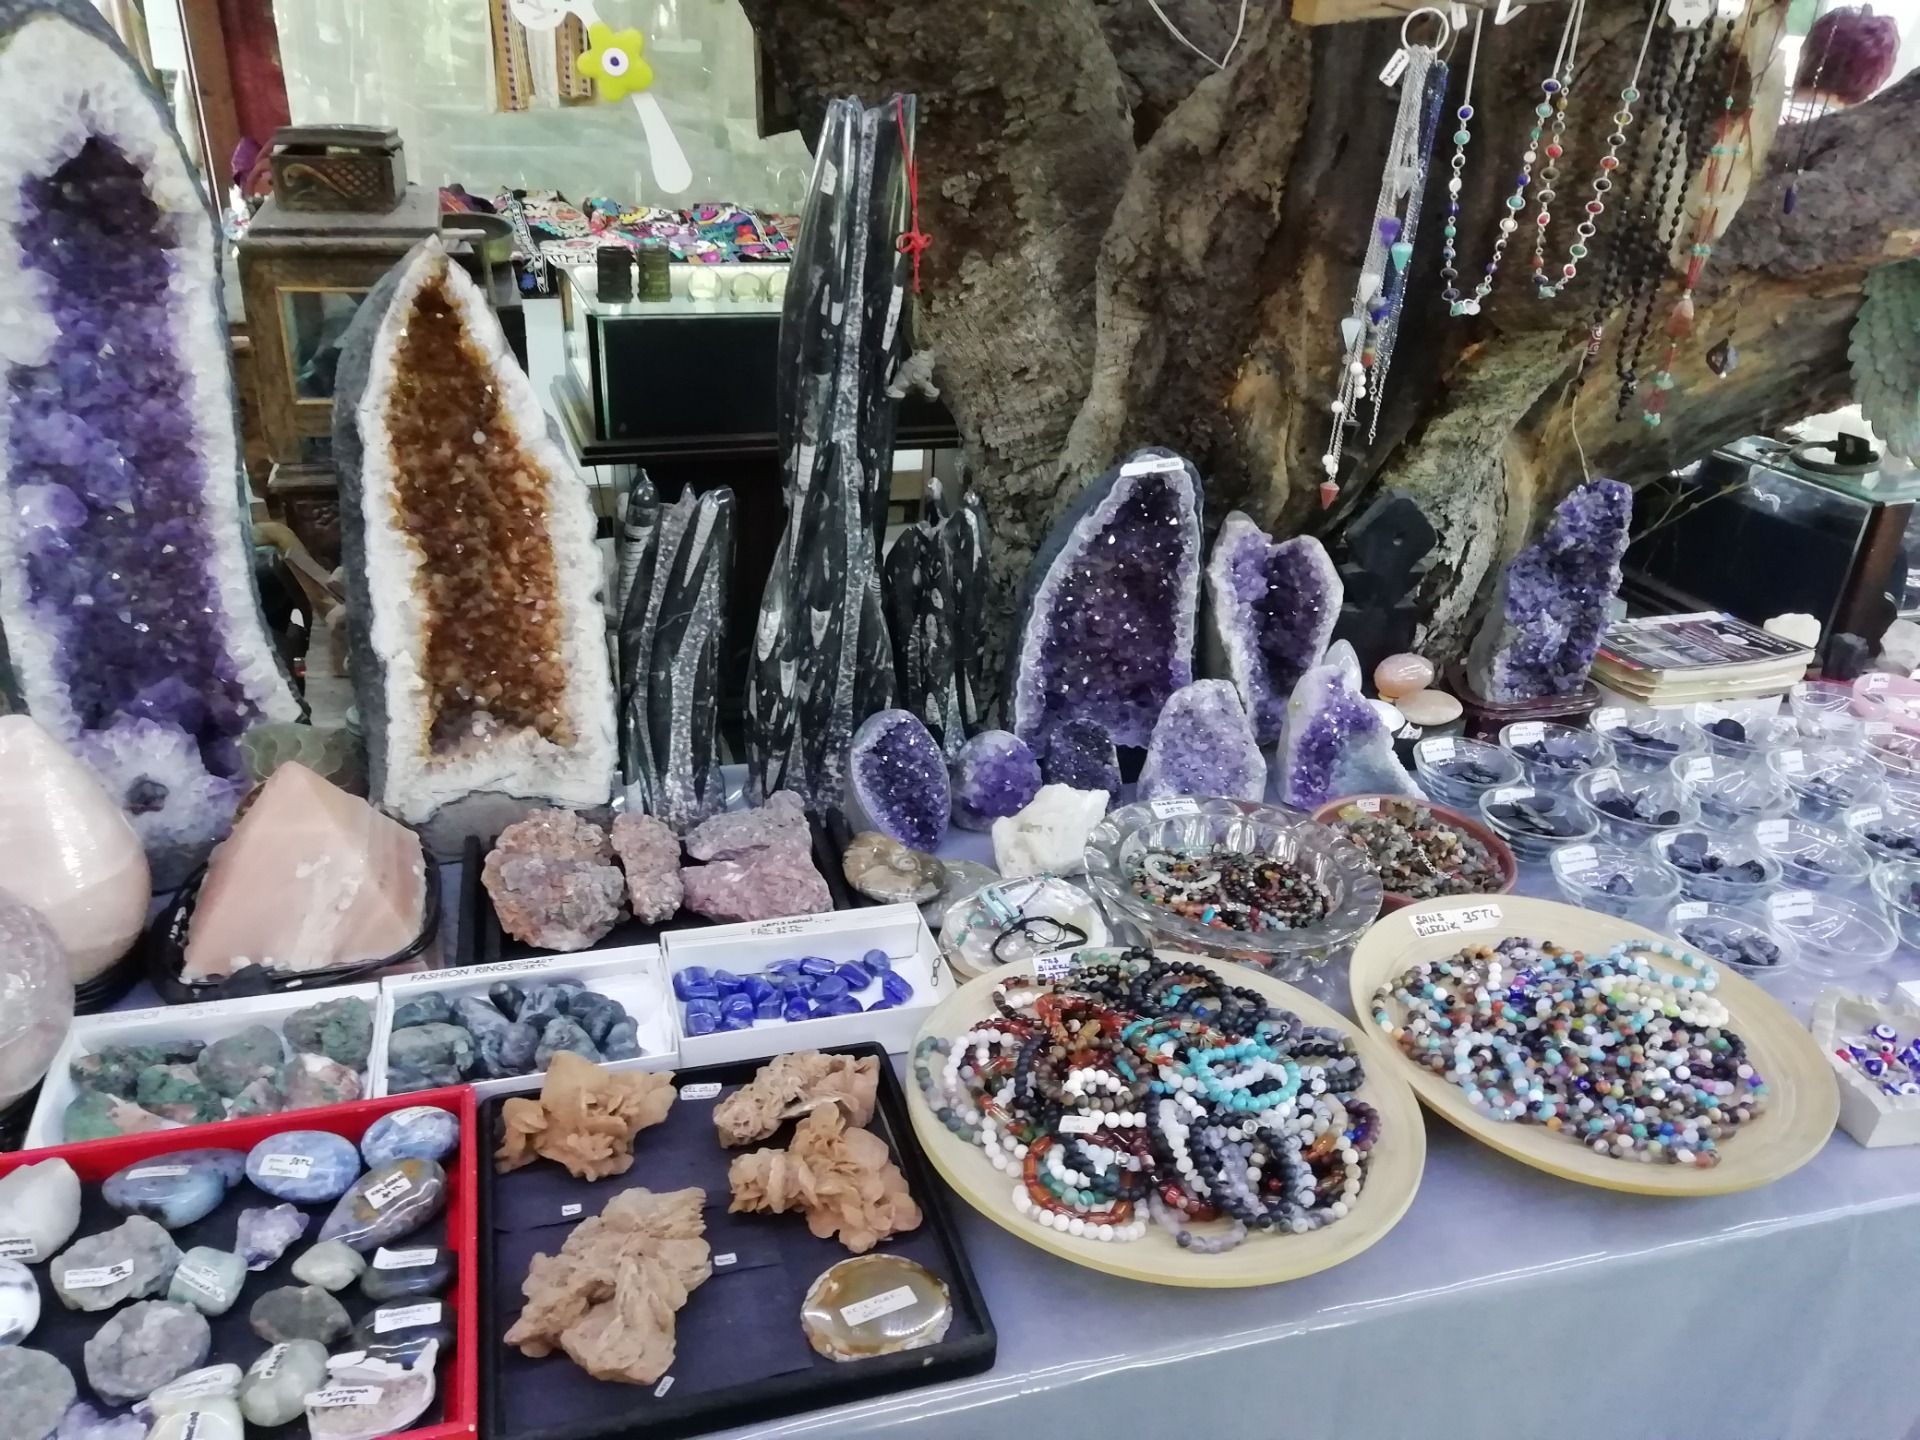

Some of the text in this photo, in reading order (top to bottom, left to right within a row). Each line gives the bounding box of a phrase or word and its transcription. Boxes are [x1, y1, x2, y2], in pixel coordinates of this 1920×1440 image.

[1461, 909, 1501, 924] 35TL
[410, 968, 470, 982] FASHION
[474, 962, 516, 975] RINGS
